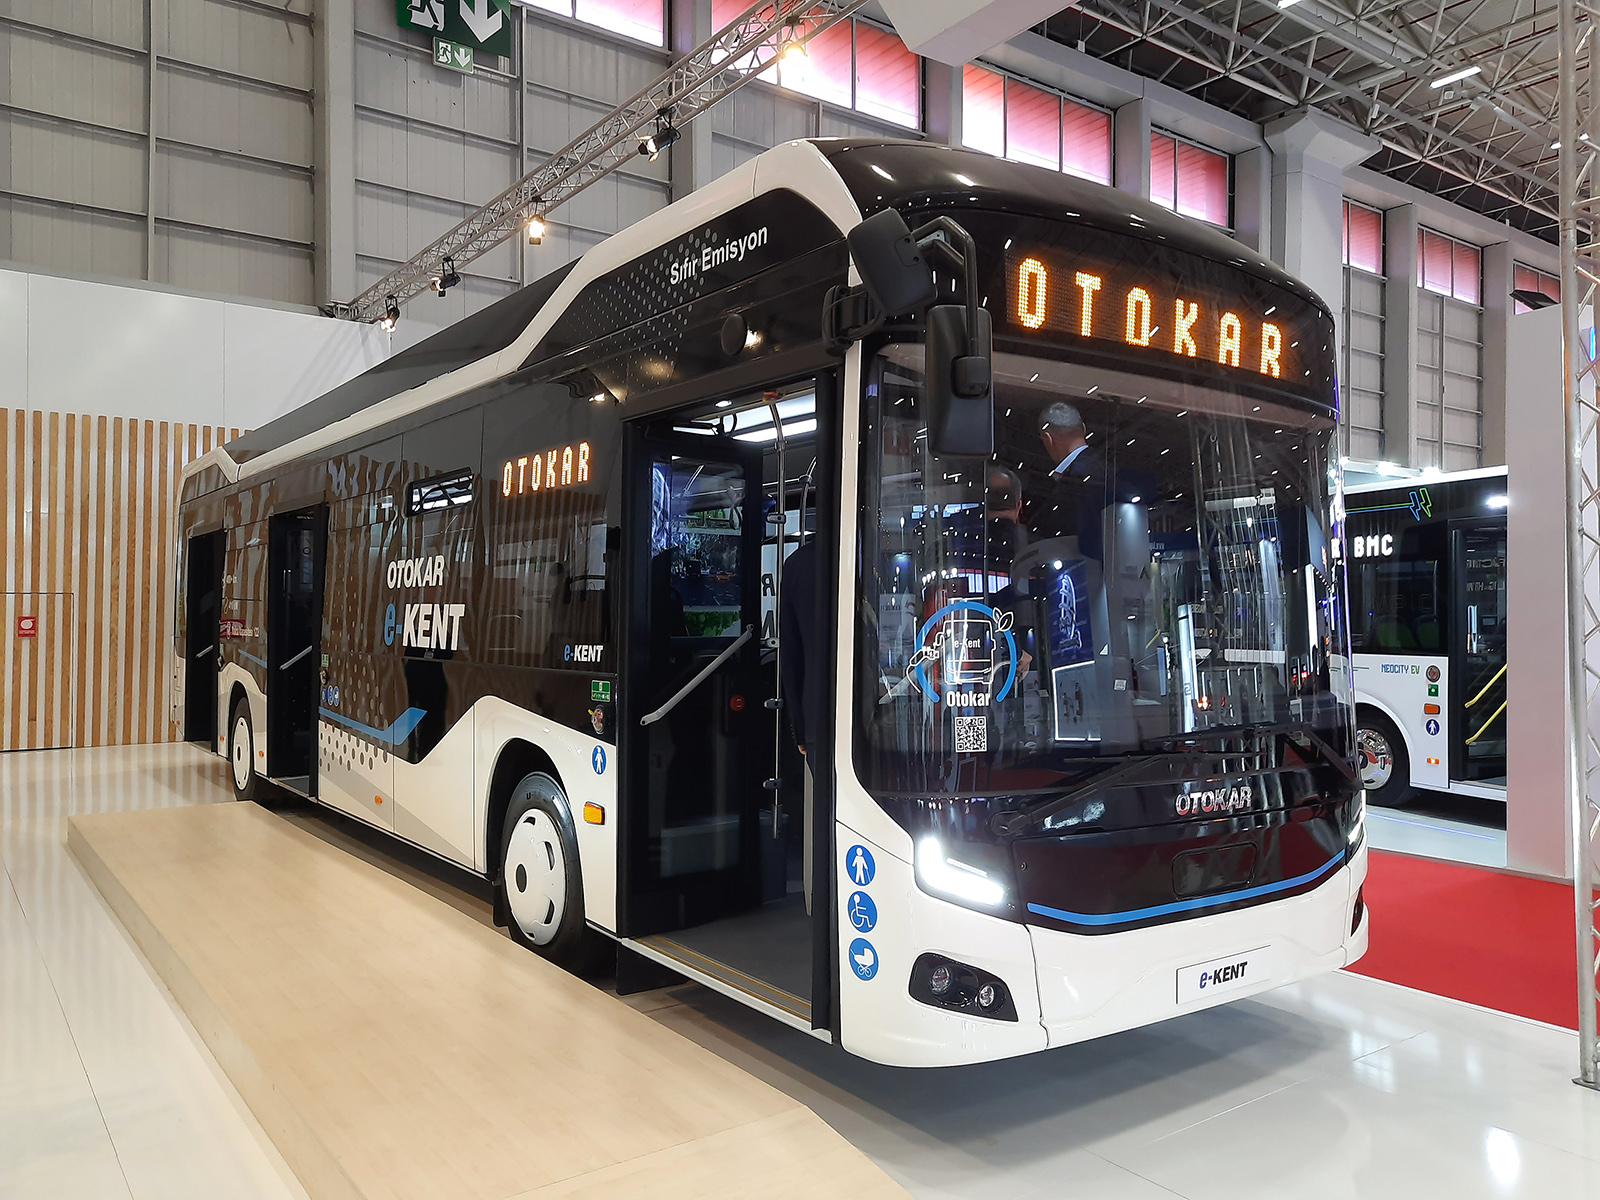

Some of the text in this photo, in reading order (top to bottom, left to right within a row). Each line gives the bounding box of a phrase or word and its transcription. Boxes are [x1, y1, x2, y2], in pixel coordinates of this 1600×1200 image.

[670, 226, 768, 285] Sıfır Emisyon
[1017, 257, 1282, 379] OTOKAR
[502, 441, 590, 497] OTOKAR
[1354, 534, 1393, 558] BMC
[387, 555, 445, 589] OTOKAR
[384, 602, 466, 650] e-KENT
[564, 644, 604, 662] e-KENT
[954, 638, 981, 650] e-Kent
[1381, 664, 1420, 675] NEOCITY EV
[947, 690, 991, 707] Otokar
[1175, 786, 1253, 816] OTOKAR
[1199, 960, 1248, 989] e-KENT
